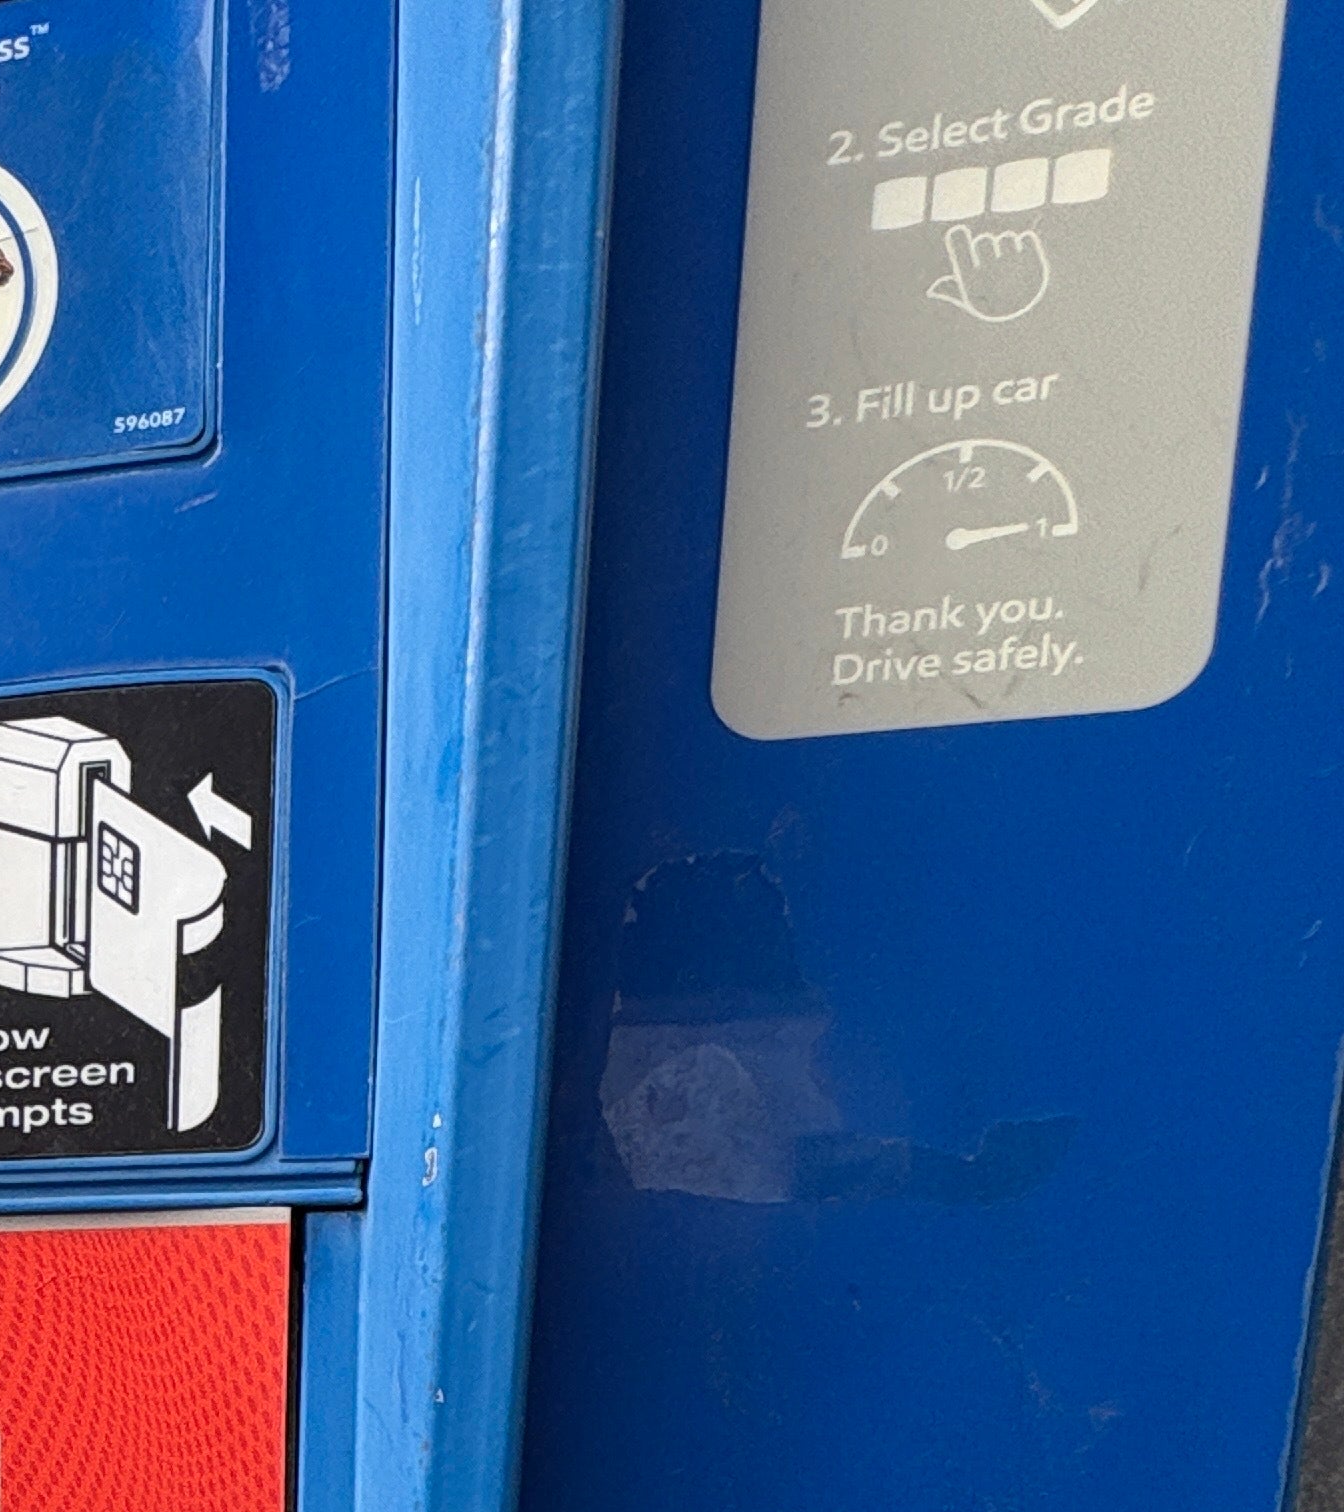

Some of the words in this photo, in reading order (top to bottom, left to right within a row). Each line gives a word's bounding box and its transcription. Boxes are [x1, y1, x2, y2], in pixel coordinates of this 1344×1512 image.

[827, 131, 864, 165] 2.
[878, 107, 1012, 158] Select
[1019, 84, 1155, 135] Grade
[113, 407, 185, 433] 596087
[806, 395, 842, 428] 3.
[856, 380, 914, 423] Fill
[929, 384, 980, 420] up
[992, 373, 1059, 404] car
[943, 467, 985, 493] 1/2
[835, 596, 966, 639] Thank
[976, 597, 1064, 634] you.
[832, 653, 941, 685] Drive
[952, 634, 1084, 675] safely.
